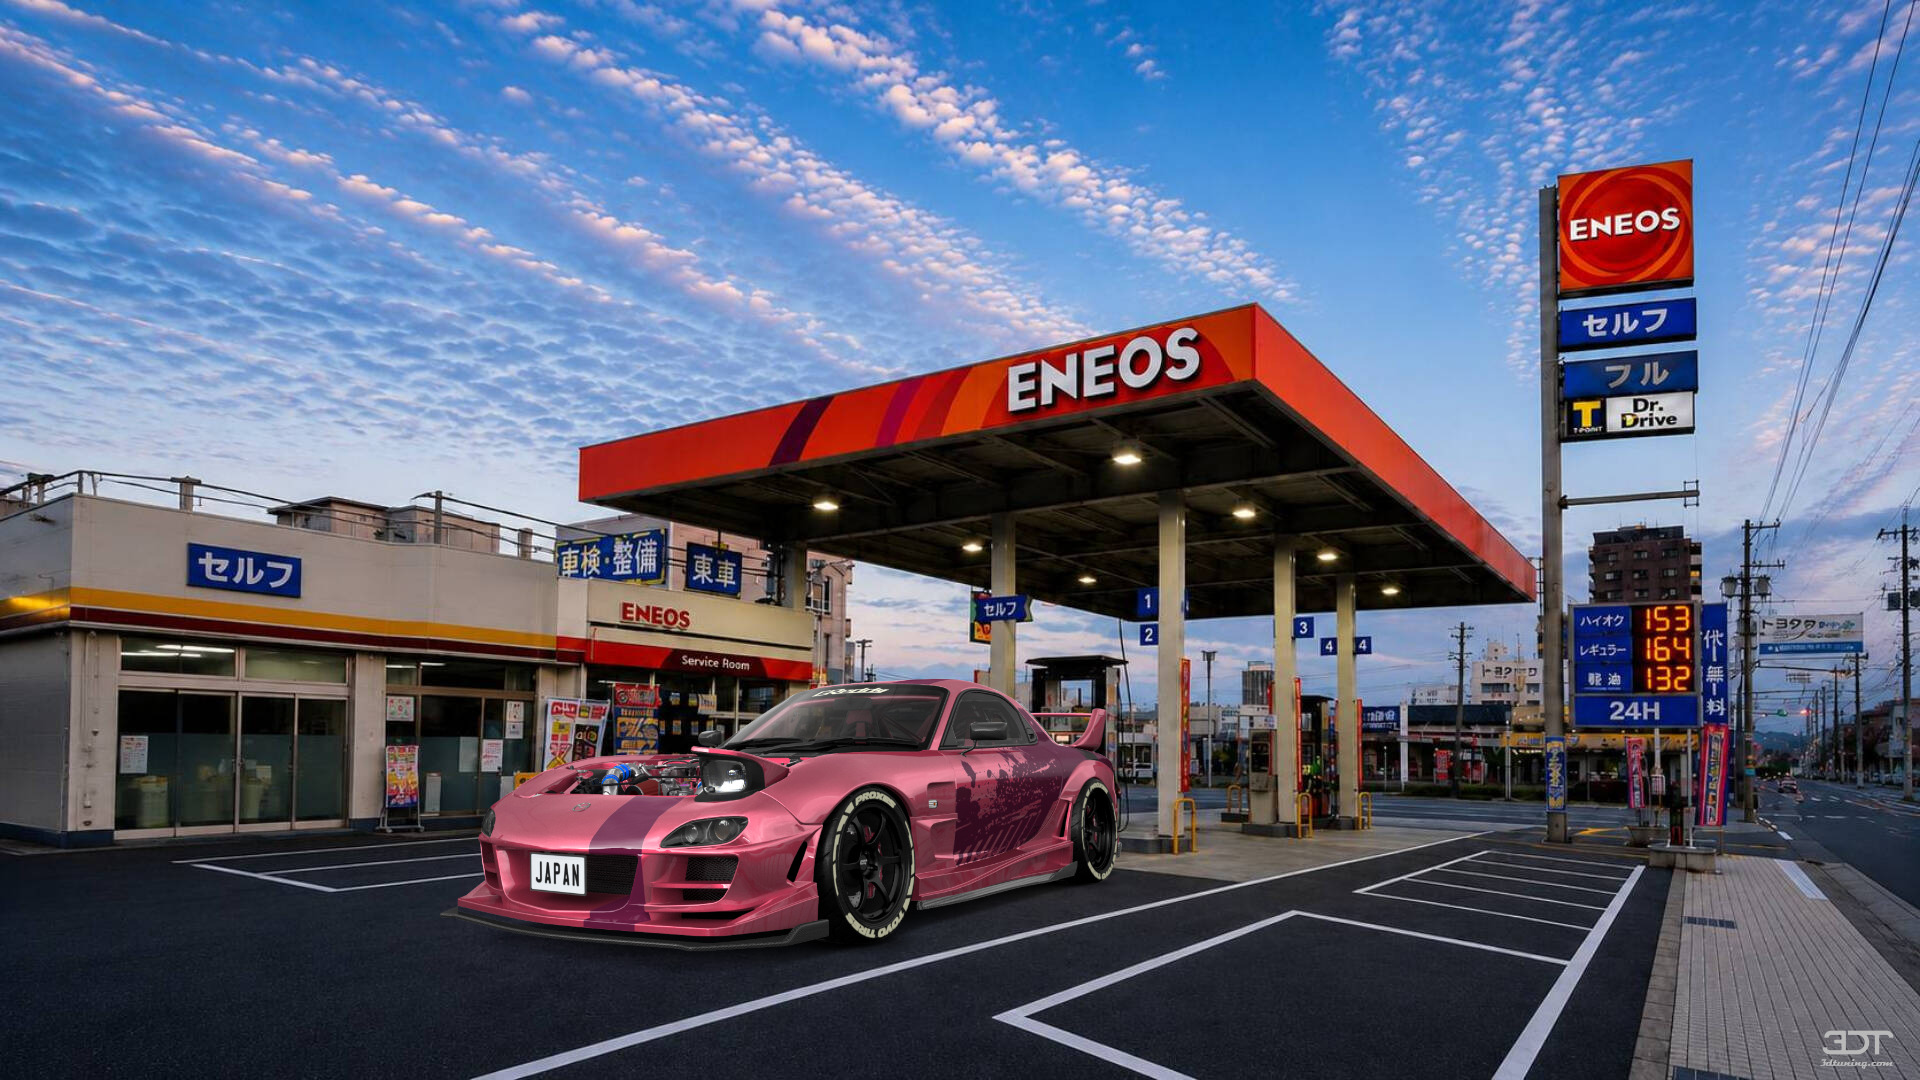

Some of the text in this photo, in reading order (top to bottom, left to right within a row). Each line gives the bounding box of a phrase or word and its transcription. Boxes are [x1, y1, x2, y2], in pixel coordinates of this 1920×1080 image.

[1569, 207, 1680, 241] ENEOS
[1582, 308, 1668, 337] セルフ
[1008, 327, 1200, 412] ENEOS
[1605, 361, 1669, 389] フル
[1572, 401, 1601, 428] T
[1633, 398, 1664, 413] Dr.
[1621, 413, 1678, 432] Drive
[198, 551, 293, 588] セルフ
[692, 553, 736, 588] 東車
[984, 602, 1016, 616] セルフ
[1144, 594, 1152, 609] 1
[621, 602, 690, 629] ENEOS
[1580, 614, 1625, 627] ハイオク
[1646, 605, 1690, 632] 153
[1144, 628, 1153, 642] 2
[1299, 621, 1308, 634] 3
[1325, 641, 1334, 653] 4
[1358, 639, 1367, 651] 4
[1580, 644, 1627, 656] レギュラー
[1646, 636, 1690, 661] 164
[681, 654, 751, 671] Service Room
[1646, 666, 1690, 691] 132
[1609, 701, 1661, 721] 24H
[855, 791, 896, 809] PROXES
[535, 861, 580, 887] JAPAN
